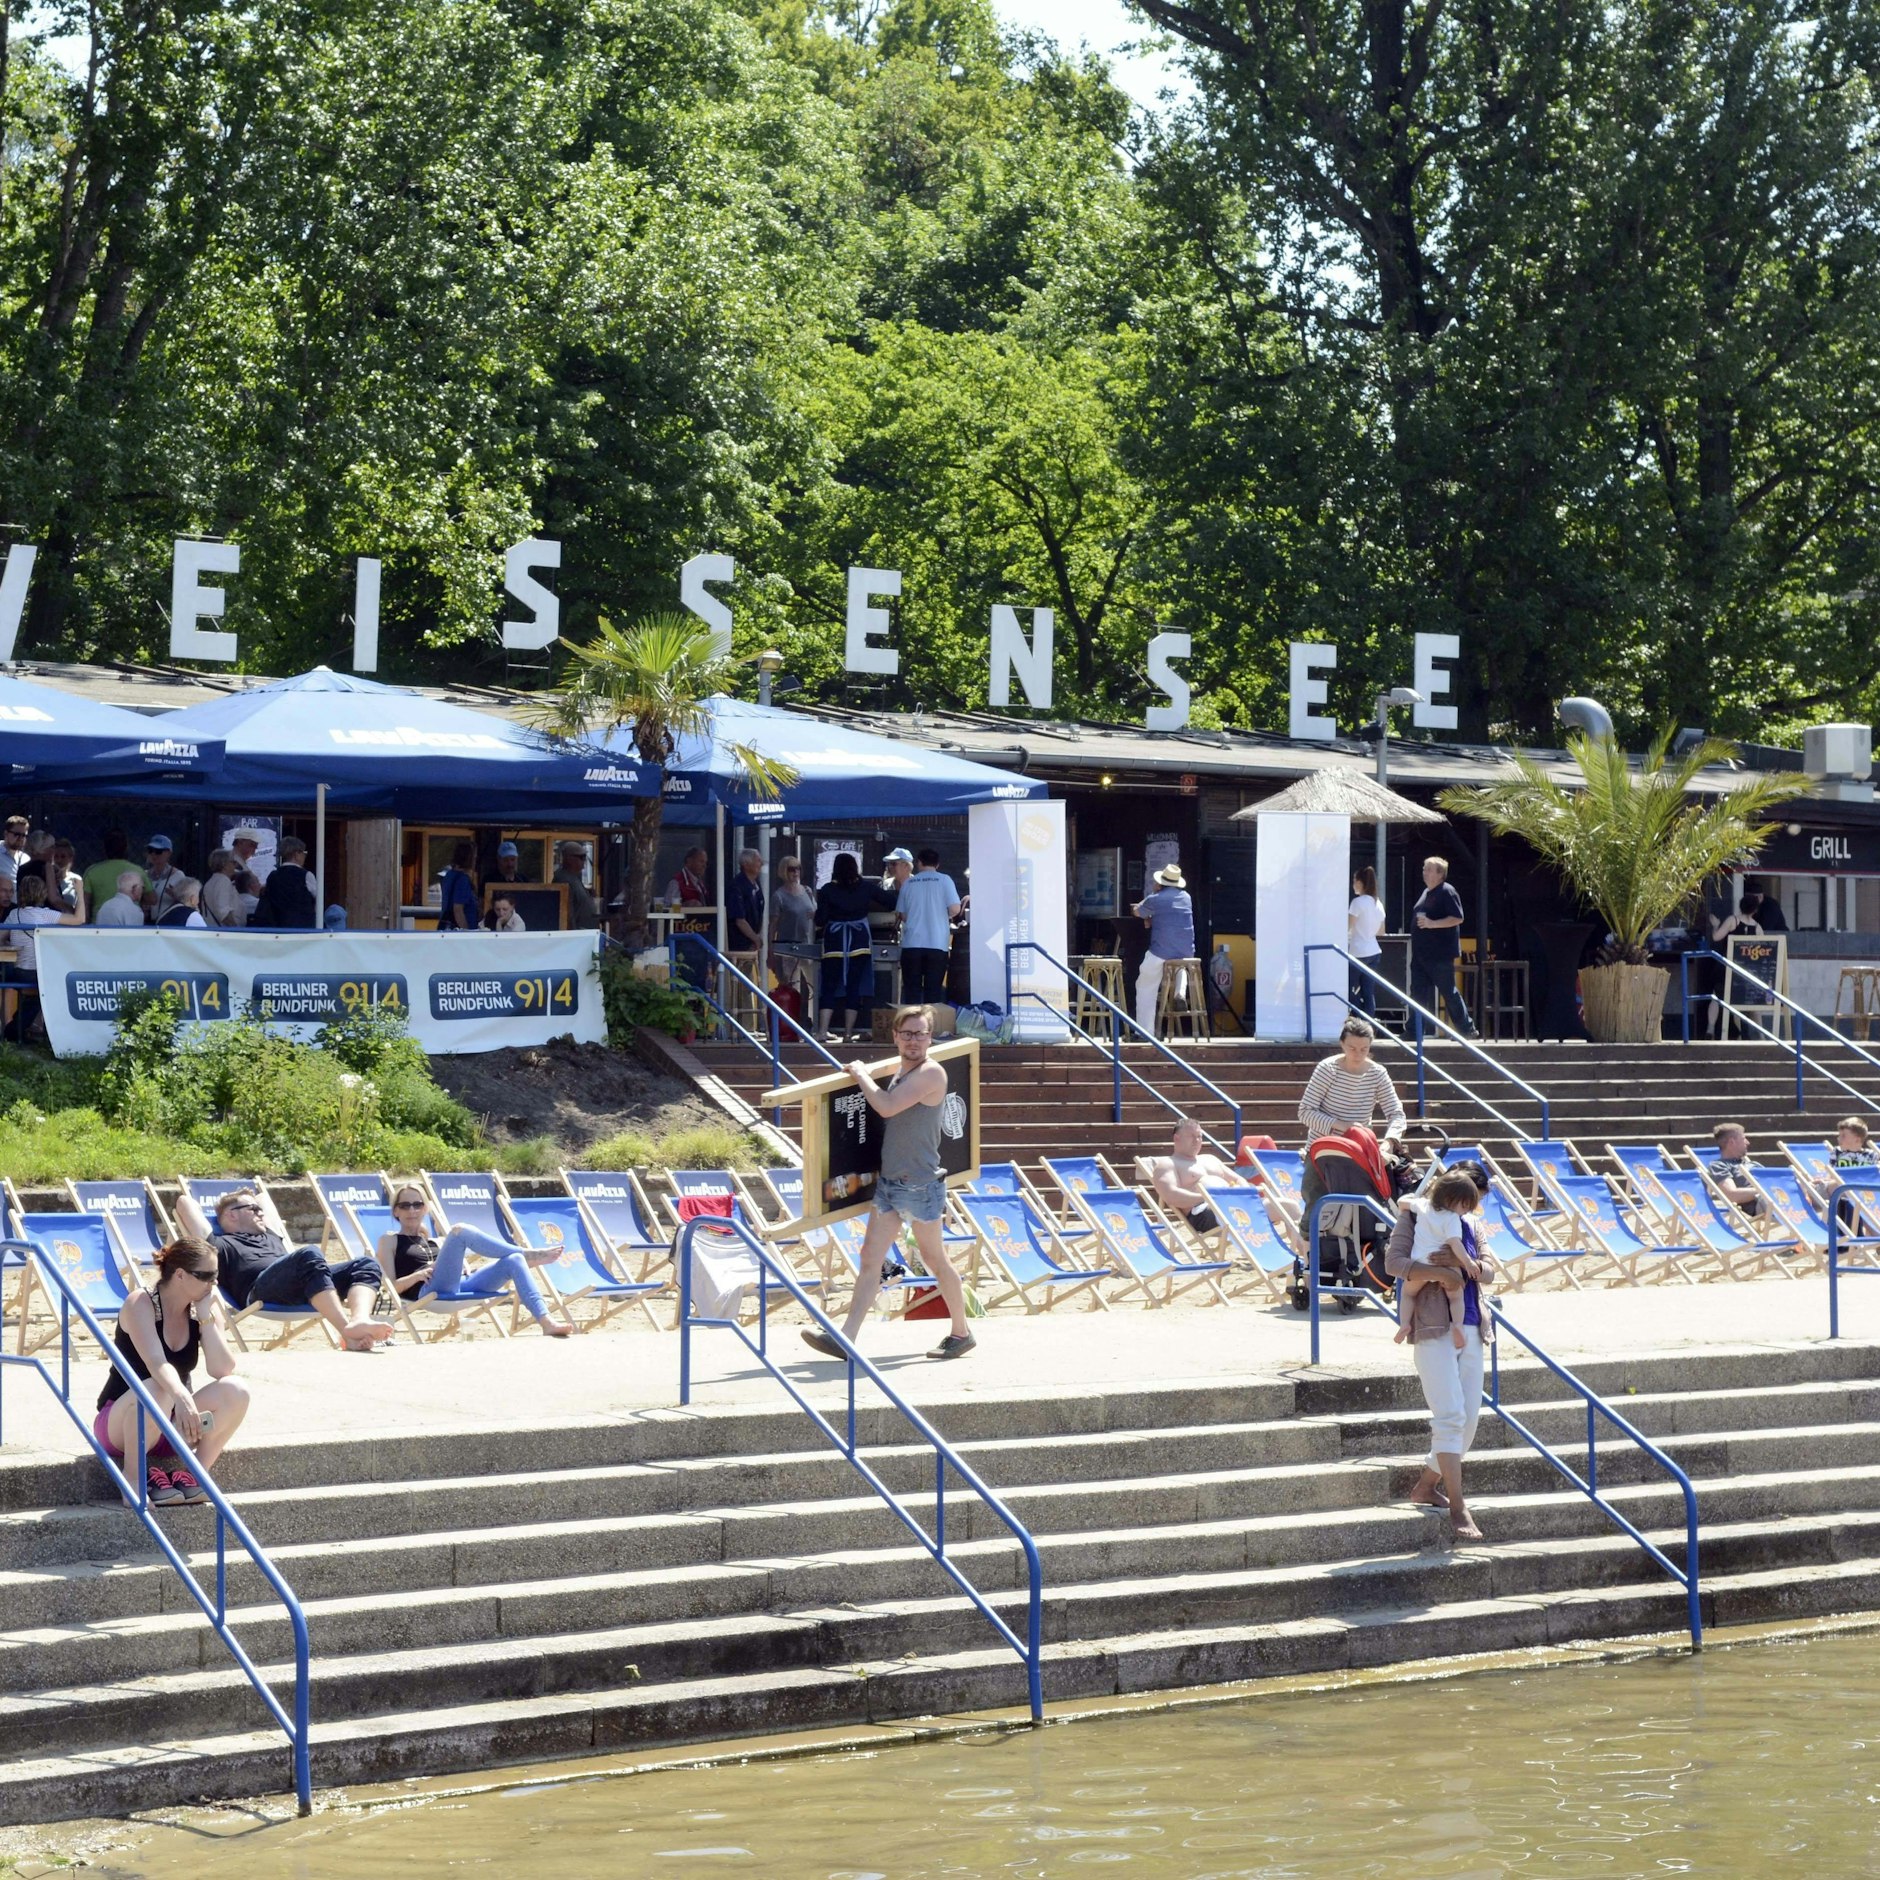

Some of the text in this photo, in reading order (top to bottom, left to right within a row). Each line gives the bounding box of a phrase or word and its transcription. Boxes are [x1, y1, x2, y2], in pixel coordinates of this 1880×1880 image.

[139, 738, 200, 758] LAVAZZA
[583, 765, 639, 782] LAVAZZA
[241, 817, 258, 828] BAR
[1810, 836, 1852, 860] GRILL
[1740, 945, 1773, 961] Tiger
[262, 982, 329, 997] BERLINER
[437, 981, 503, 996] BERLINER
[439, 996, 514, 1011] RUNDFUNK
[847, 1093, 855, 1129] WORLD
[858, 1091, 867, 1144] EXPLORING
[328, 1186, 380, 1202] LAVAZZA
[441, 1184, 492, 1200] LAVAZZA
[577, 1183, 628, 1198] LAVAZZA
[683, 1182, 730, 1196] LAVAZZA
[87, 1193, 142, 1210] LAVAZZA
